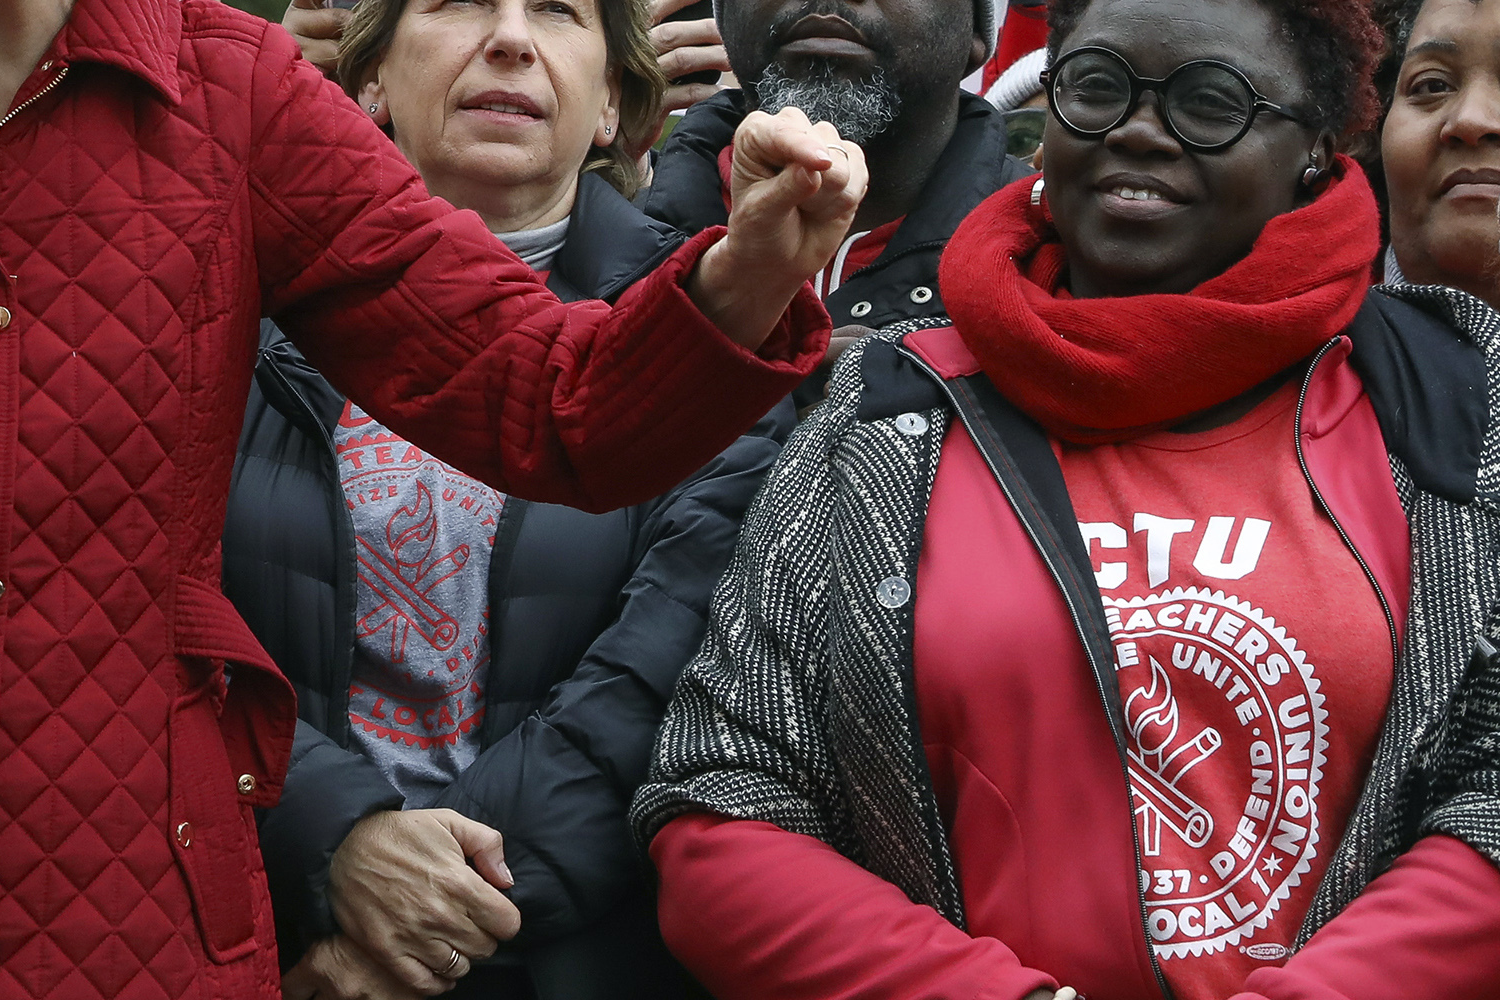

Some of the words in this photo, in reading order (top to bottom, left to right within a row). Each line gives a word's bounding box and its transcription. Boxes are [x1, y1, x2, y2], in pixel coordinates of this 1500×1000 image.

[1081, 512, 1272, 589] CTU
[1171, 642, 1263, 728] UNITE
[1104, 603, 1290, 686] EACHERS
[1275, 692, 1312, 858] UNION
[1209, 740, 1274, 882] DEFEND
[1149, 891, 1258, 942] OCAL
[1250, 868, 1271, 897] 1
